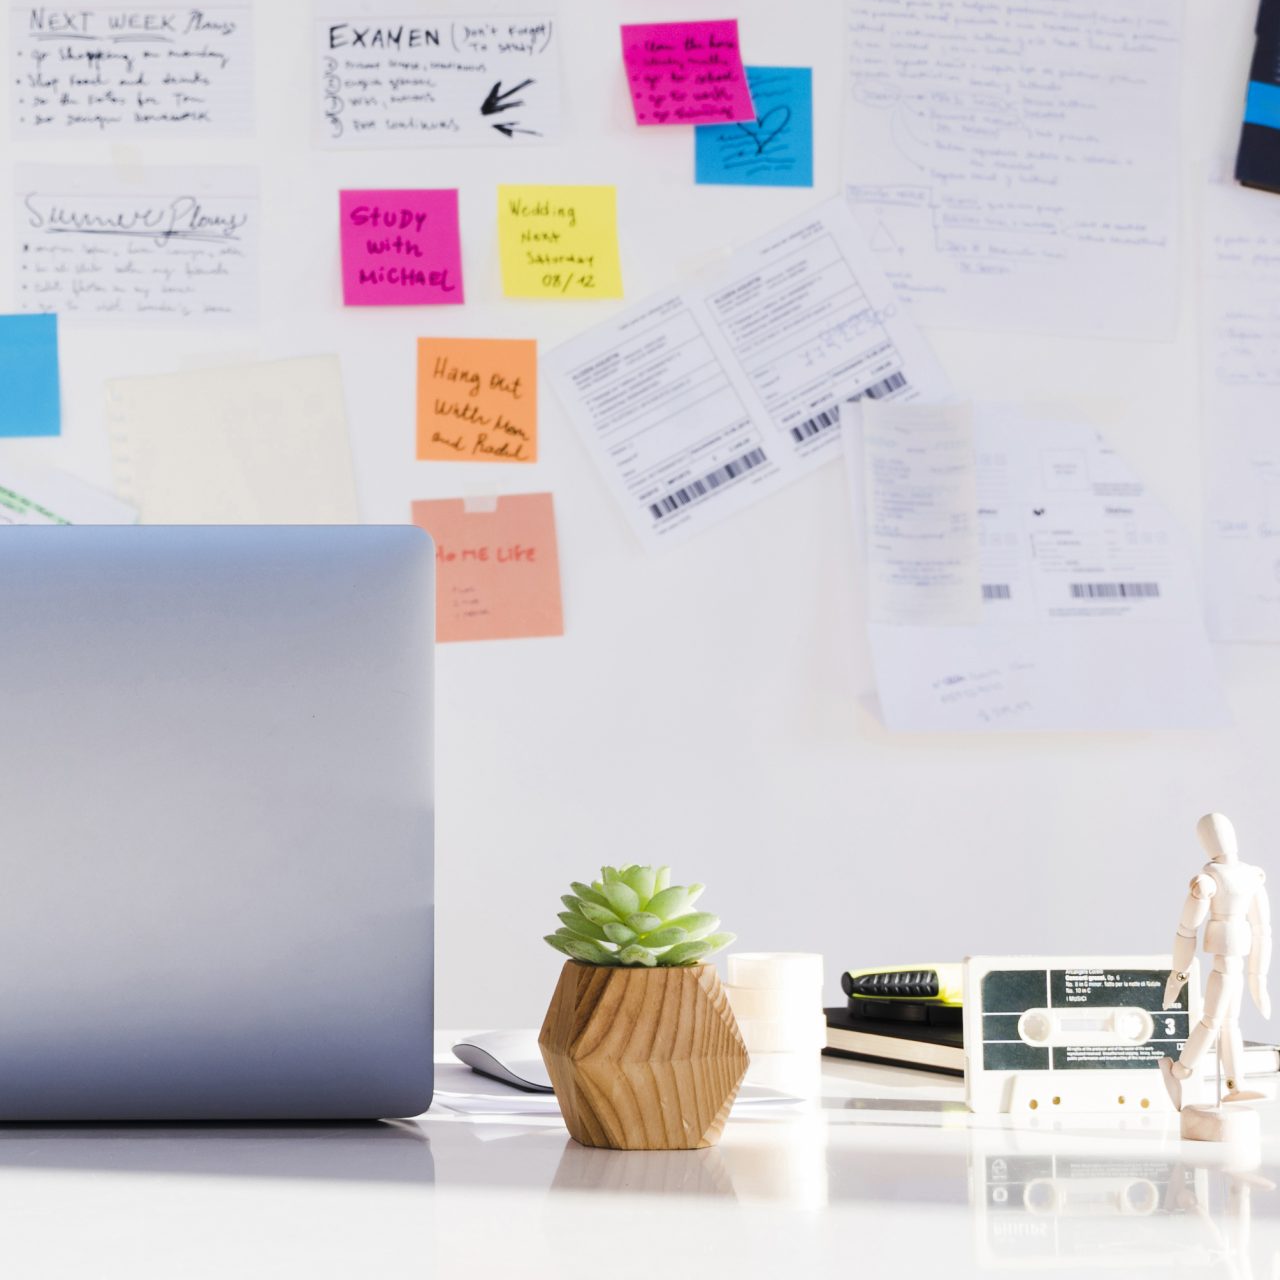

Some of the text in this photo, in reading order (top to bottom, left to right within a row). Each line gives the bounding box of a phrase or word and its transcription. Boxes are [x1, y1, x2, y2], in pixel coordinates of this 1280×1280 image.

[29, 6, 94, 32] NEXT
[107, 12, 177, 32] WEEK
[329, 23, 440, 51] EXAMEN
[1164, 1018, 1176, 1035] 3
